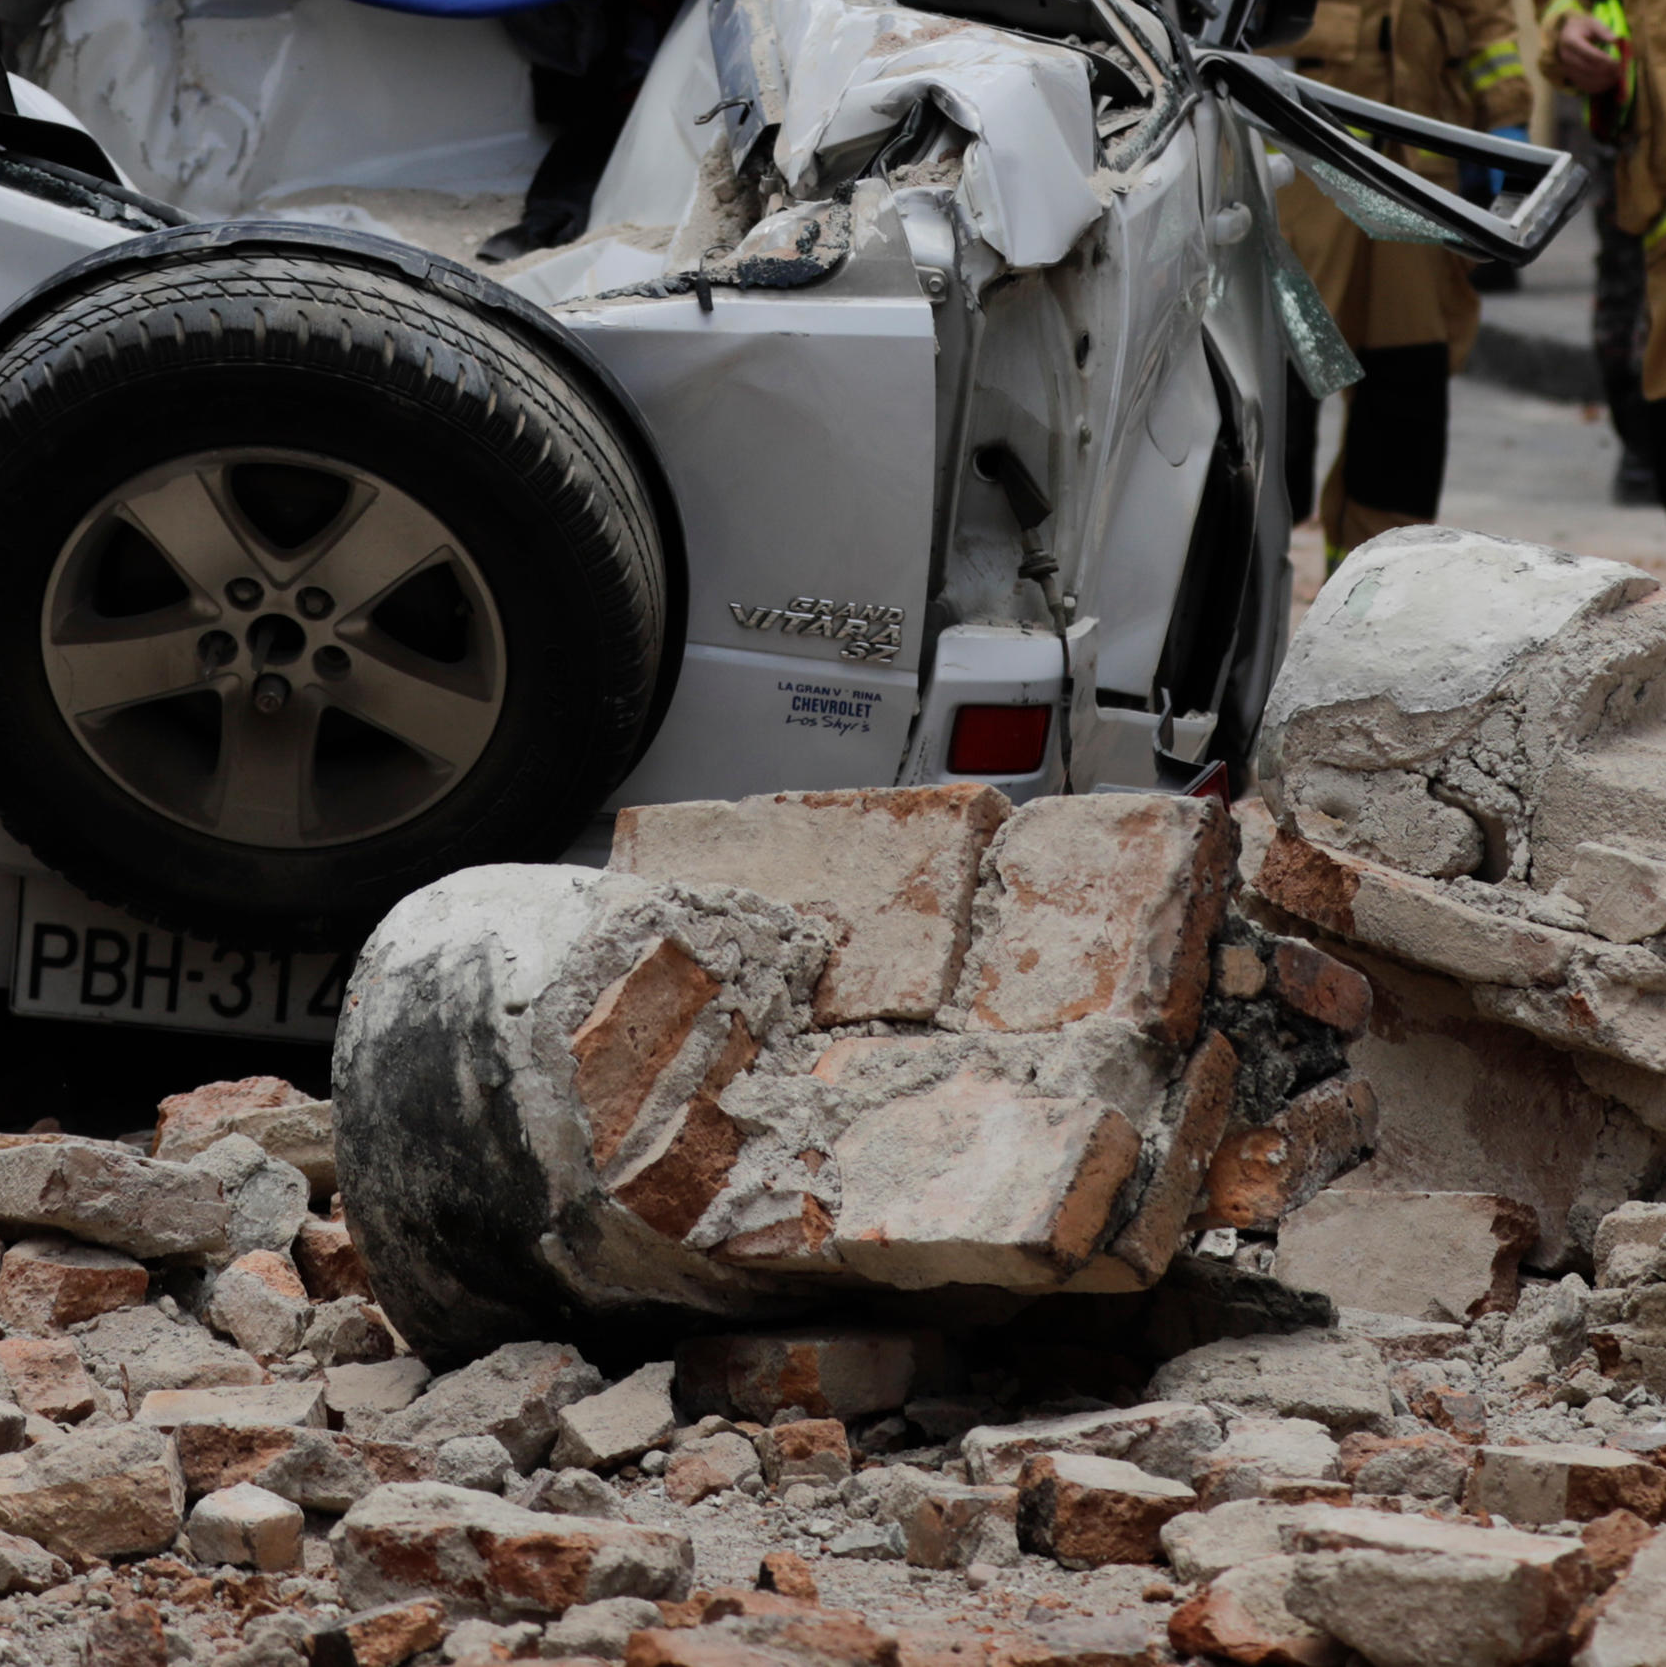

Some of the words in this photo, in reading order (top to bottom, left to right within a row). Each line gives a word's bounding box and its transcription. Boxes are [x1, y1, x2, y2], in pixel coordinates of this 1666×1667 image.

[788, 596, 905, 624] GRAND
[729, 602, 902, 647] VITARA
[840, 641, 900, 663] SZ
[777, 681, 794, 692] LA
[795, 684, 831, 696] GRAN
[792, 695, 872, 719] CHEVROLET
